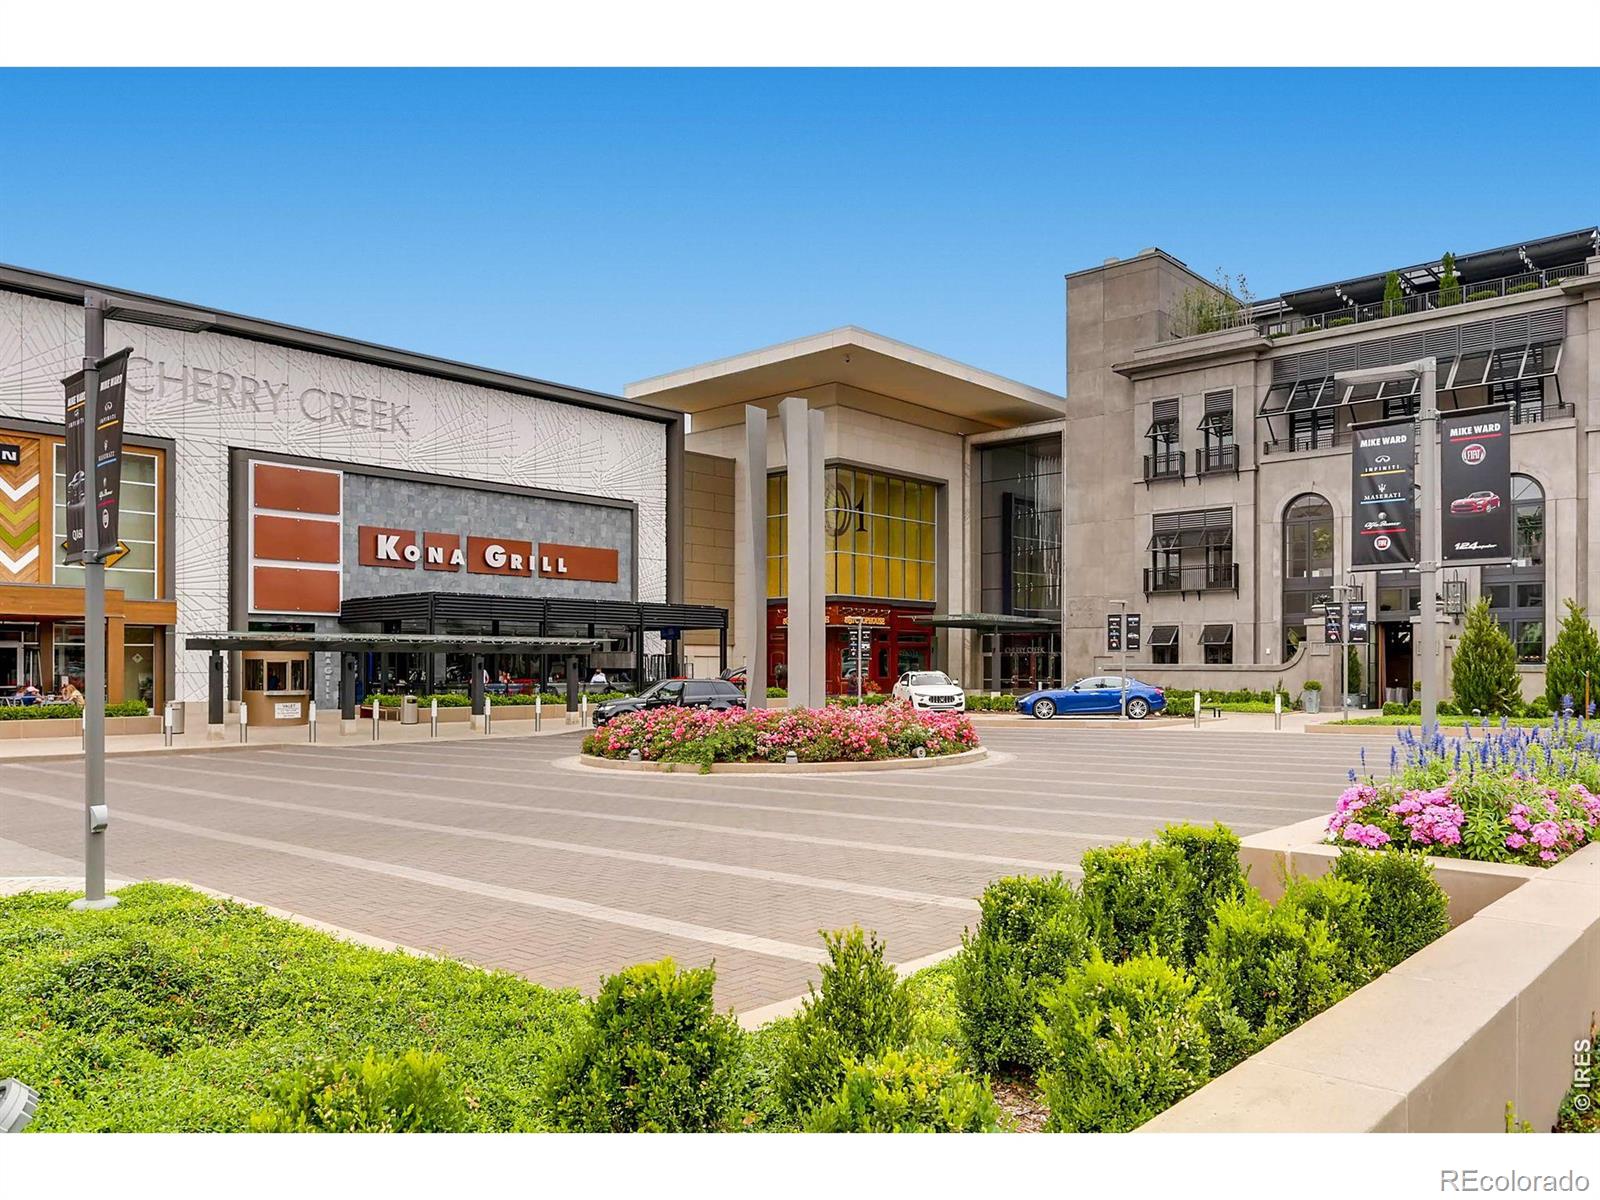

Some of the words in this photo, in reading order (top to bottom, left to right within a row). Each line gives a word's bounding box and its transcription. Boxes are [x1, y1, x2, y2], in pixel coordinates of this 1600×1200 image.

[126, 356, 289, 415] CHERRY
[300, 387, 411, 436] CREEK
[1450, 426, 1472, 437] MIKE
[1474, 423, 1501, 434] WARD
[1360, 437, 1381, 448] MIKE
[1382, 434, 1407, 445] WARD
[1365, 464, 1400, 473] INFINITI
[1363, 492, 1401, 501] MASERATI
[1454, 541, 1478, 551] 124
[376, 534, 466, 566] KONA
[484, 544, 568, 574] GRILL
